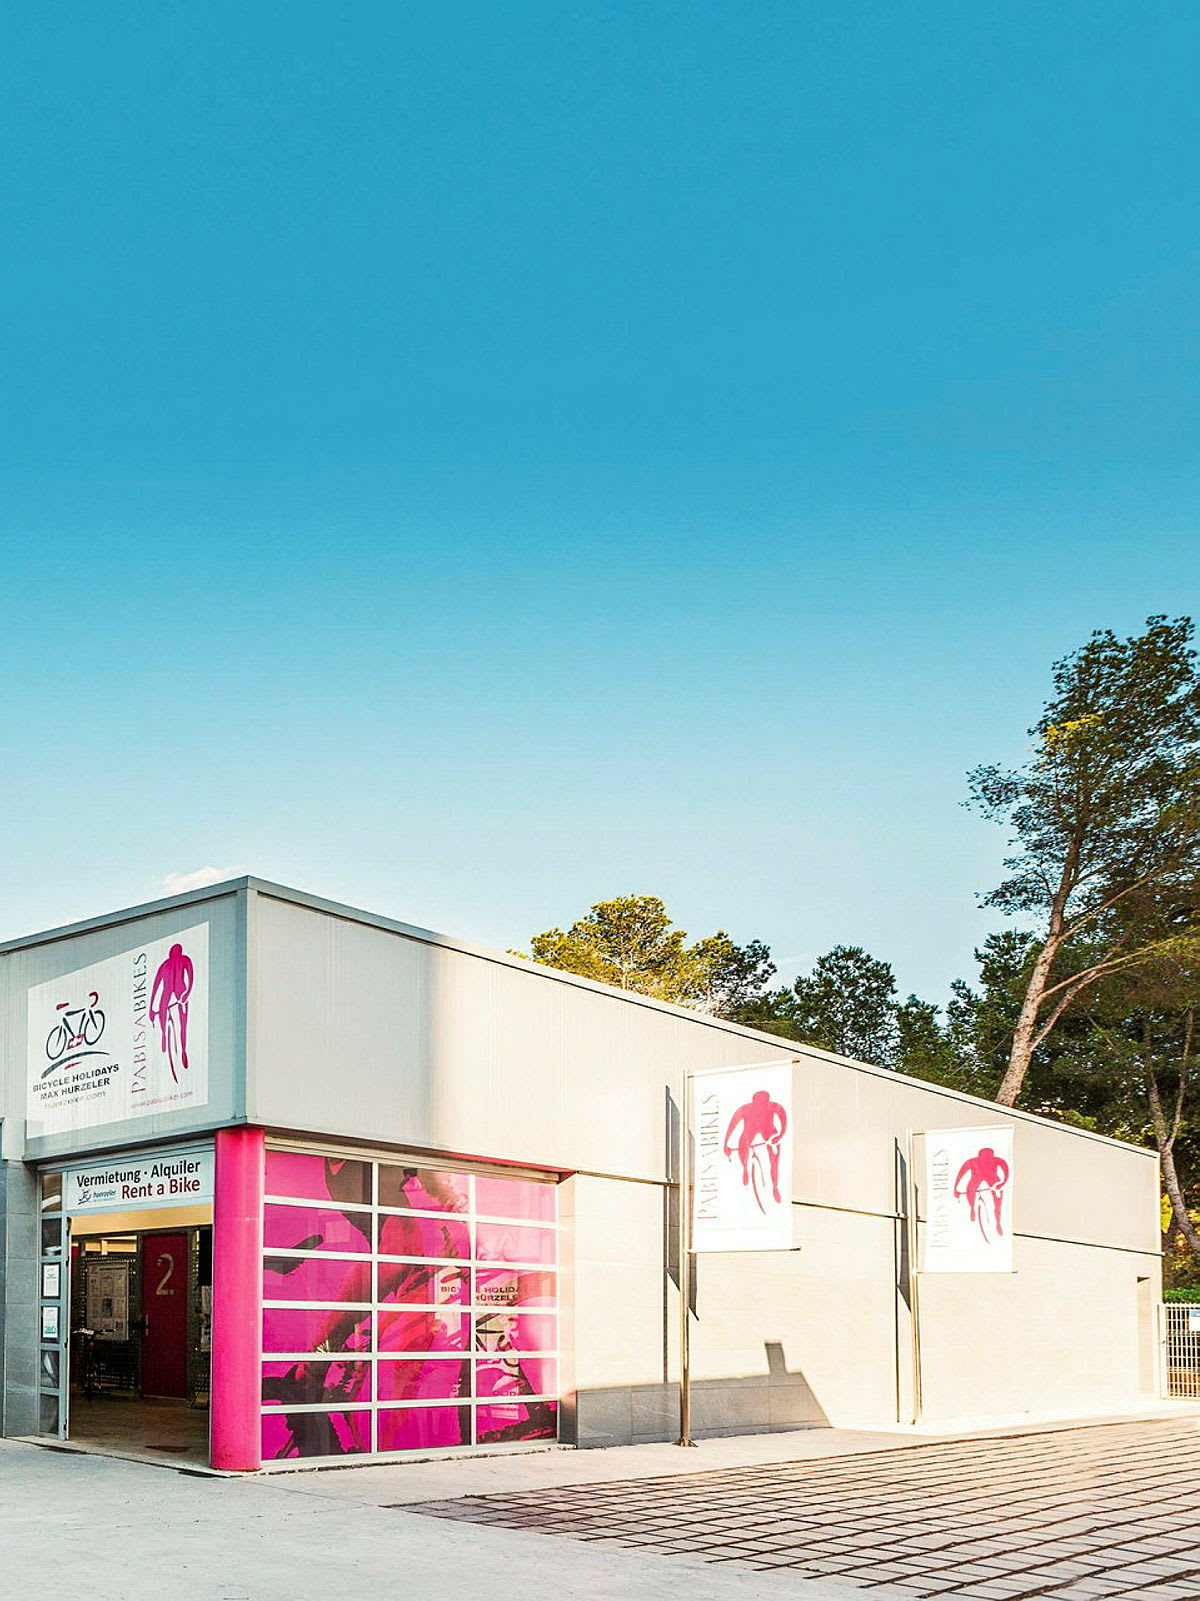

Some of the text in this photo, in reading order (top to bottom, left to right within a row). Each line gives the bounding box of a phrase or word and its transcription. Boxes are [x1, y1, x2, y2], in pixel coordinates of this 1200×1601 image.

[131, 952, 147, 1093] PABISABIKES
[32, 1063, 120, 1092] BICYCLE HOLIDAYS
[40, 1090, 59, 1101] MAX
[76, 1159, 201, 1188] Vermietung Alquiler
[121, 1176, 201, 1200] Rent a Bike
[156, 1253, 174, 1295] 2
